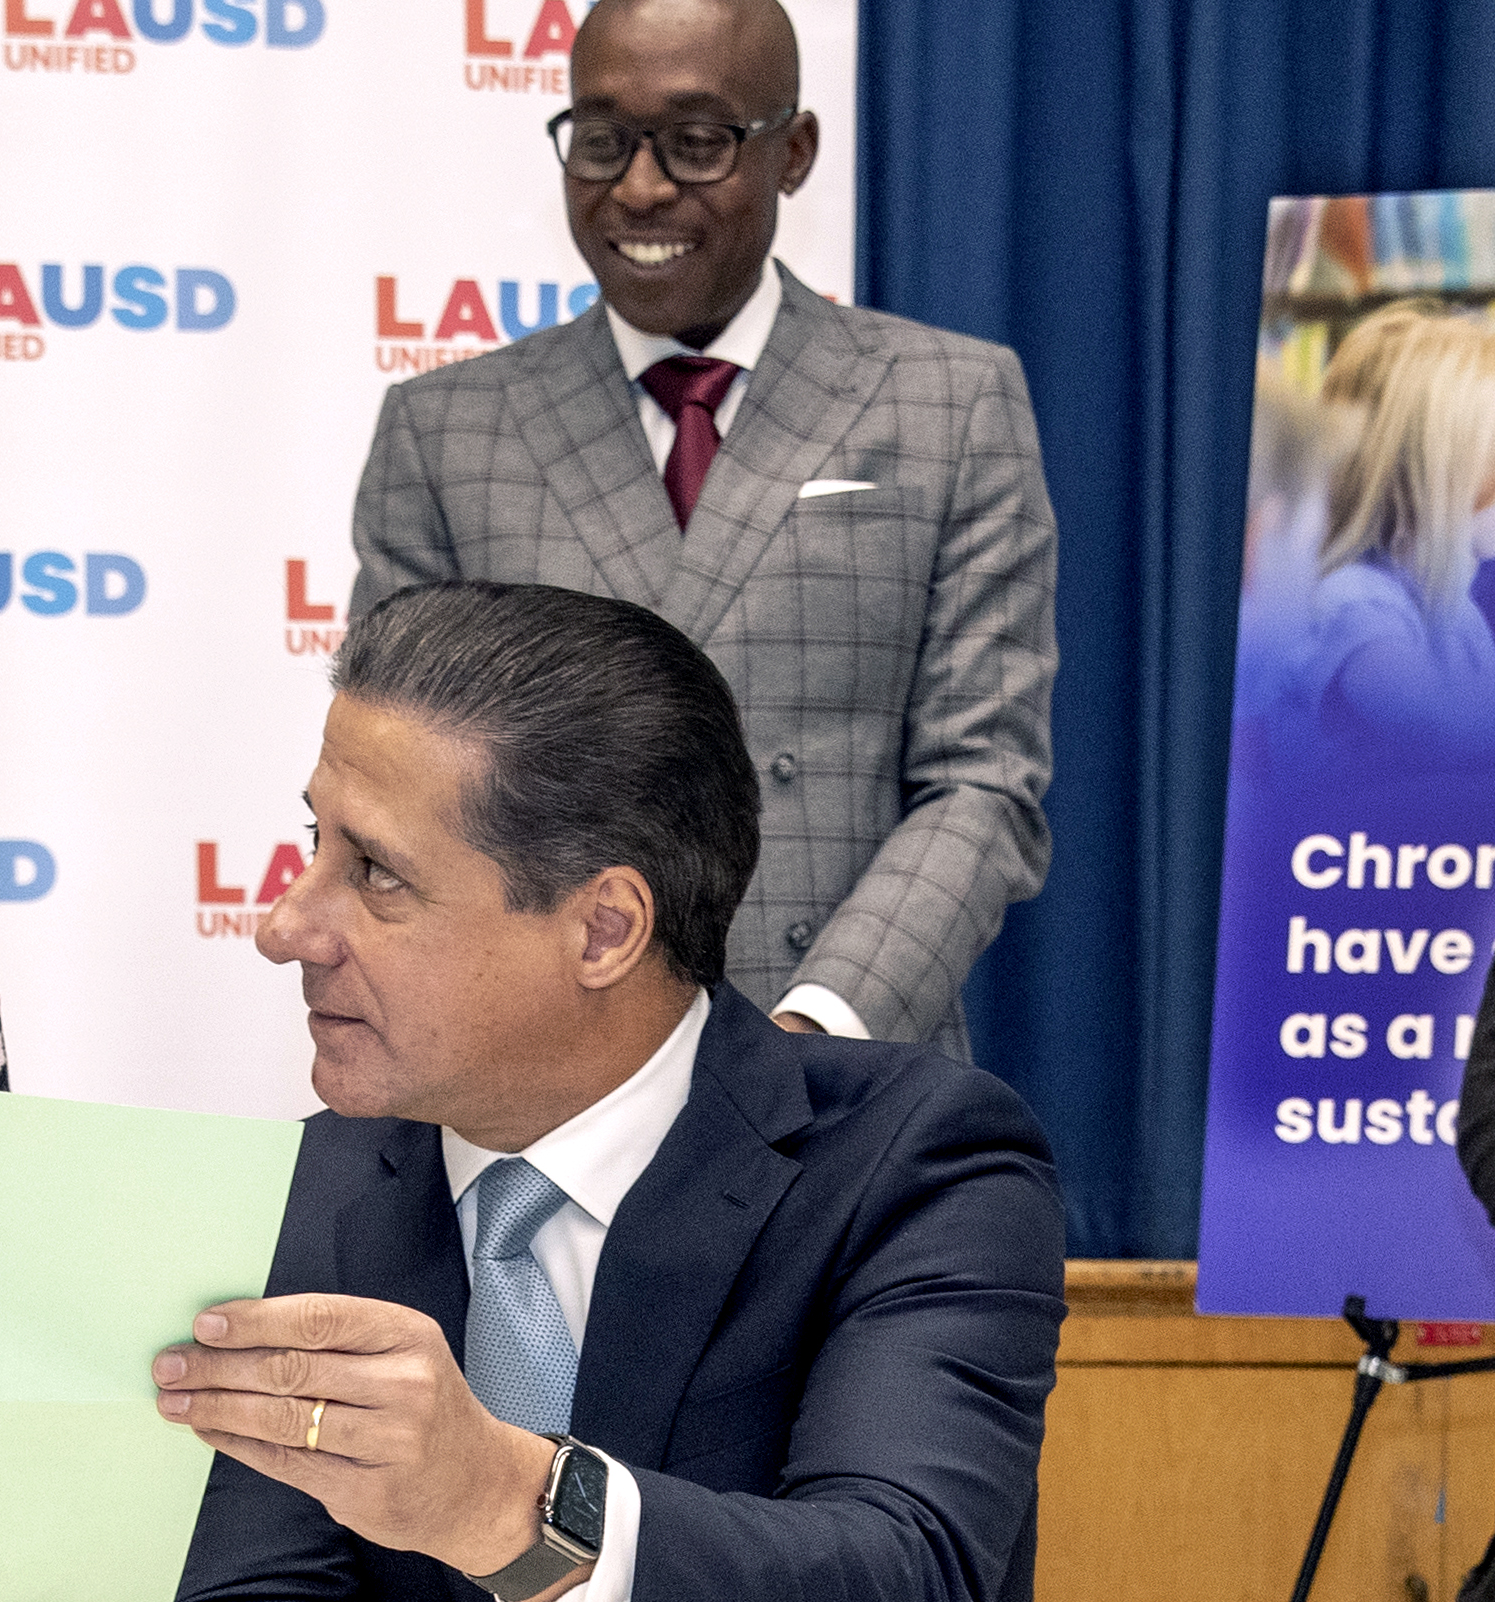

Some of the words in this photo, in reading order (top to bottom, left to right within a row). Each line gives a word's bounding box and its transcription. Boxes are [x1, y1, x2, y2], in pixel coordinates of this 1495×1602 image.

[3, 45, 136, 74] UNIFIED
[464, 64, 566, 95] UNIFIE
[376, 275, 599, 341] LAU
[1286, 915, 1475, 974] have
[1279, 1012, 1369, 1060] as
[1385, 1013, 1435, 1060] a
